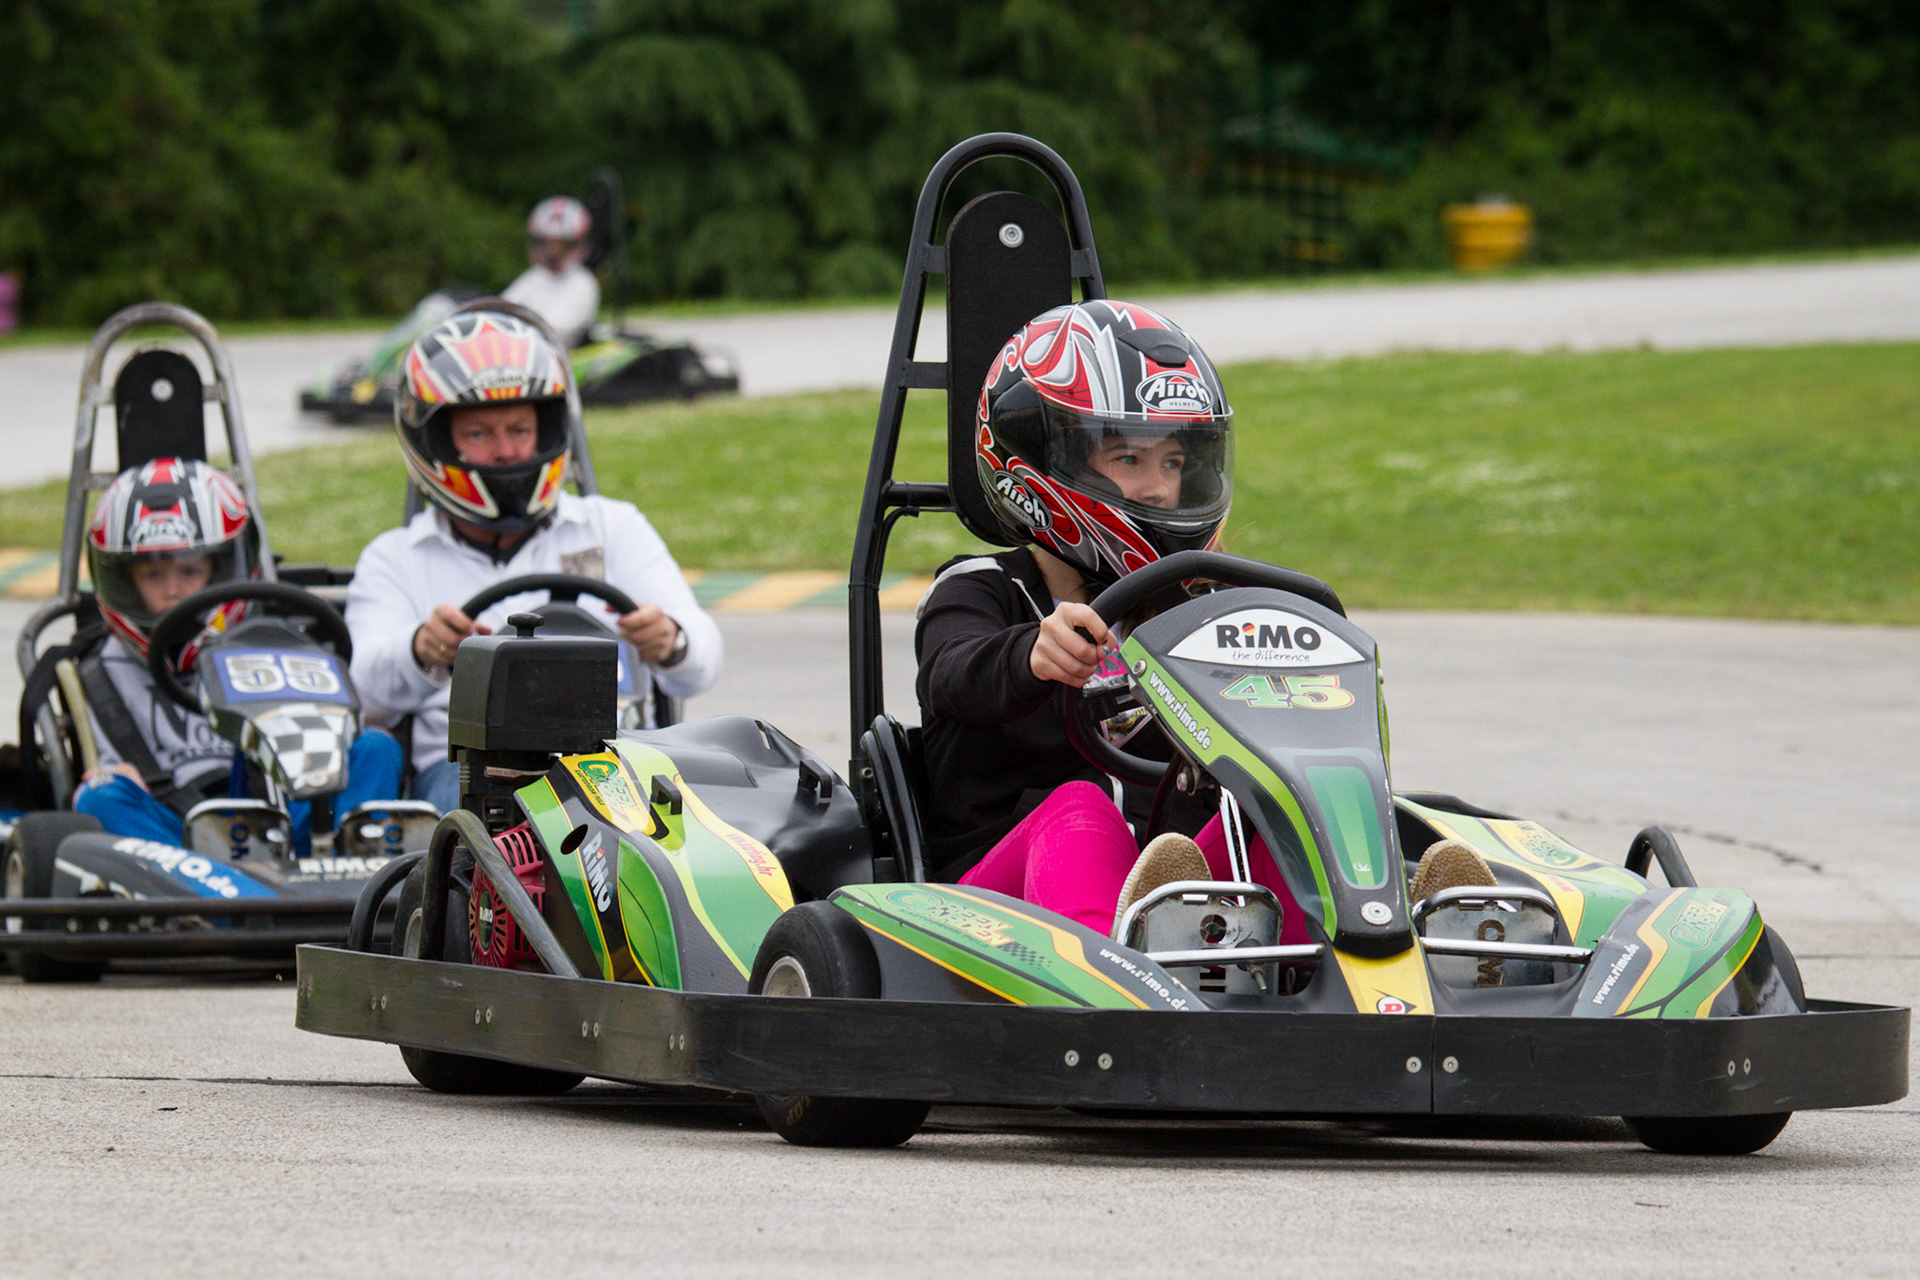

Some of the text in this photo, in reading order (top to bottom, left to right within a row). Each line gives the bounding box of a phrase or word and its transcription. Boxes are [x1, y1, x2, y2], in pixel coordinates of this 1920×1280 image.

[1144, 377, 1210, 405] Airoh
[996, 477, 1046, 527] Airoh
[224, 654, 341, 695] 55
[1232, 649, 1311, 663] the difference
[1148, 670, 1212, 750] www.rimo.de
[1218, 673, 1355, 710] 45
[1592, 943, 1640, 1005] www.rimo.de
